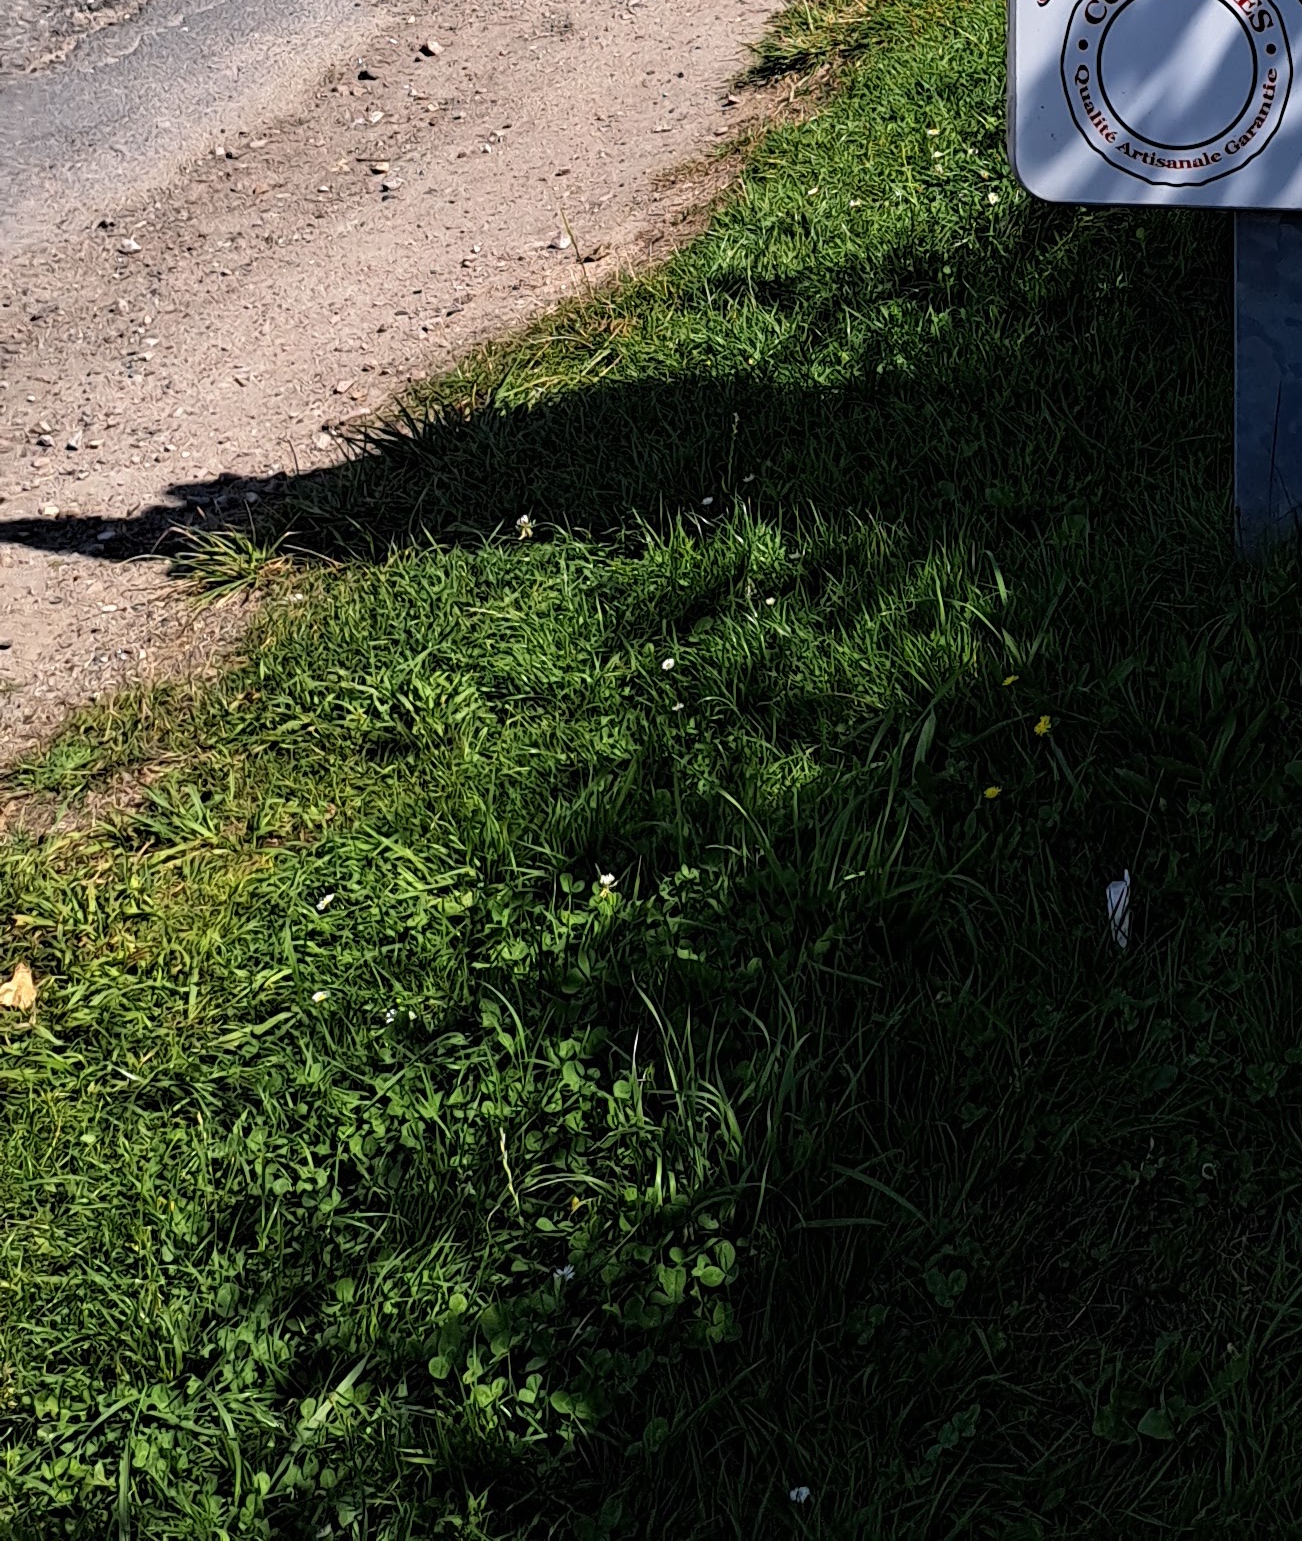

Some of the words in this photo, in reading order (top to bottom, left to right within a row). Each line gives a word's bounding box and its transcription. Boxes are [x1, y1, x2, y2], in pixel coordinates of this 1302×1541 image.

[1074, 64, 1117, 144] Qualité
[1116, 141, 1222, 169] Artisanale
[1225, 68, 1278, 156] Garantie
